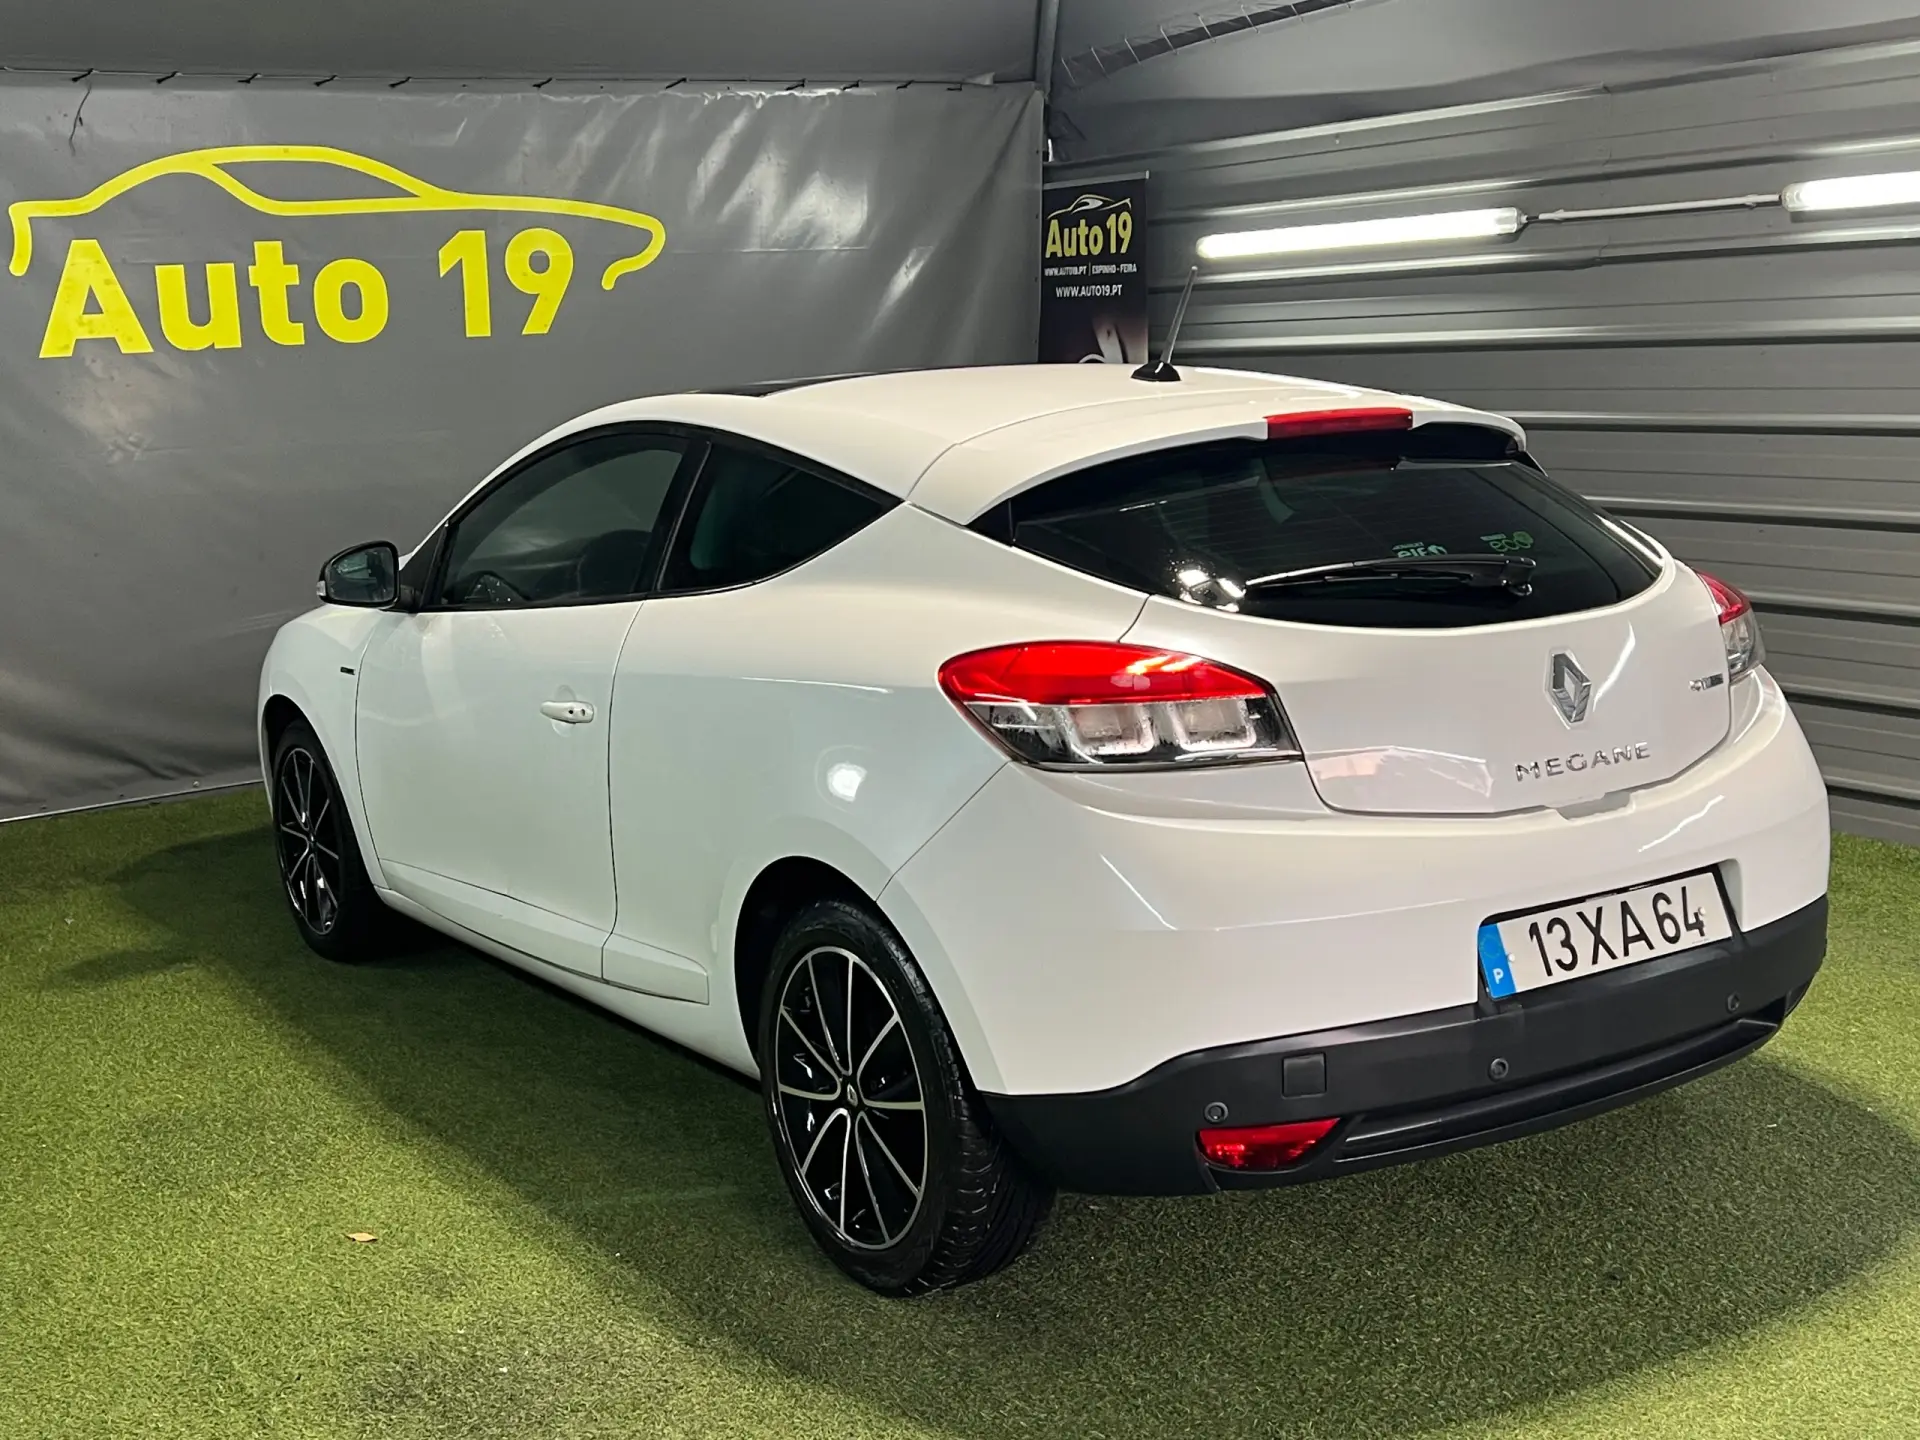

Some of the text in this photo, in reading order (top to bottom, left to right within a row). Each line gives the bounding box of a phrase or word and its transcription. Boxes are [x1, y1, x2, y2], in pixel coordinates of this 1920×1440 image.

[1045, 211, 1133, 258] Auto 19
[1120, 263, 1137, 273] FEIRA
[39, 228, 574, 358] Auto 19
[1056, 284, 1122, 297] WWW.AUTO19.PT
[1515, 741, 1651, 781] MEGANE
[1492, 966, 1504, 984] P
